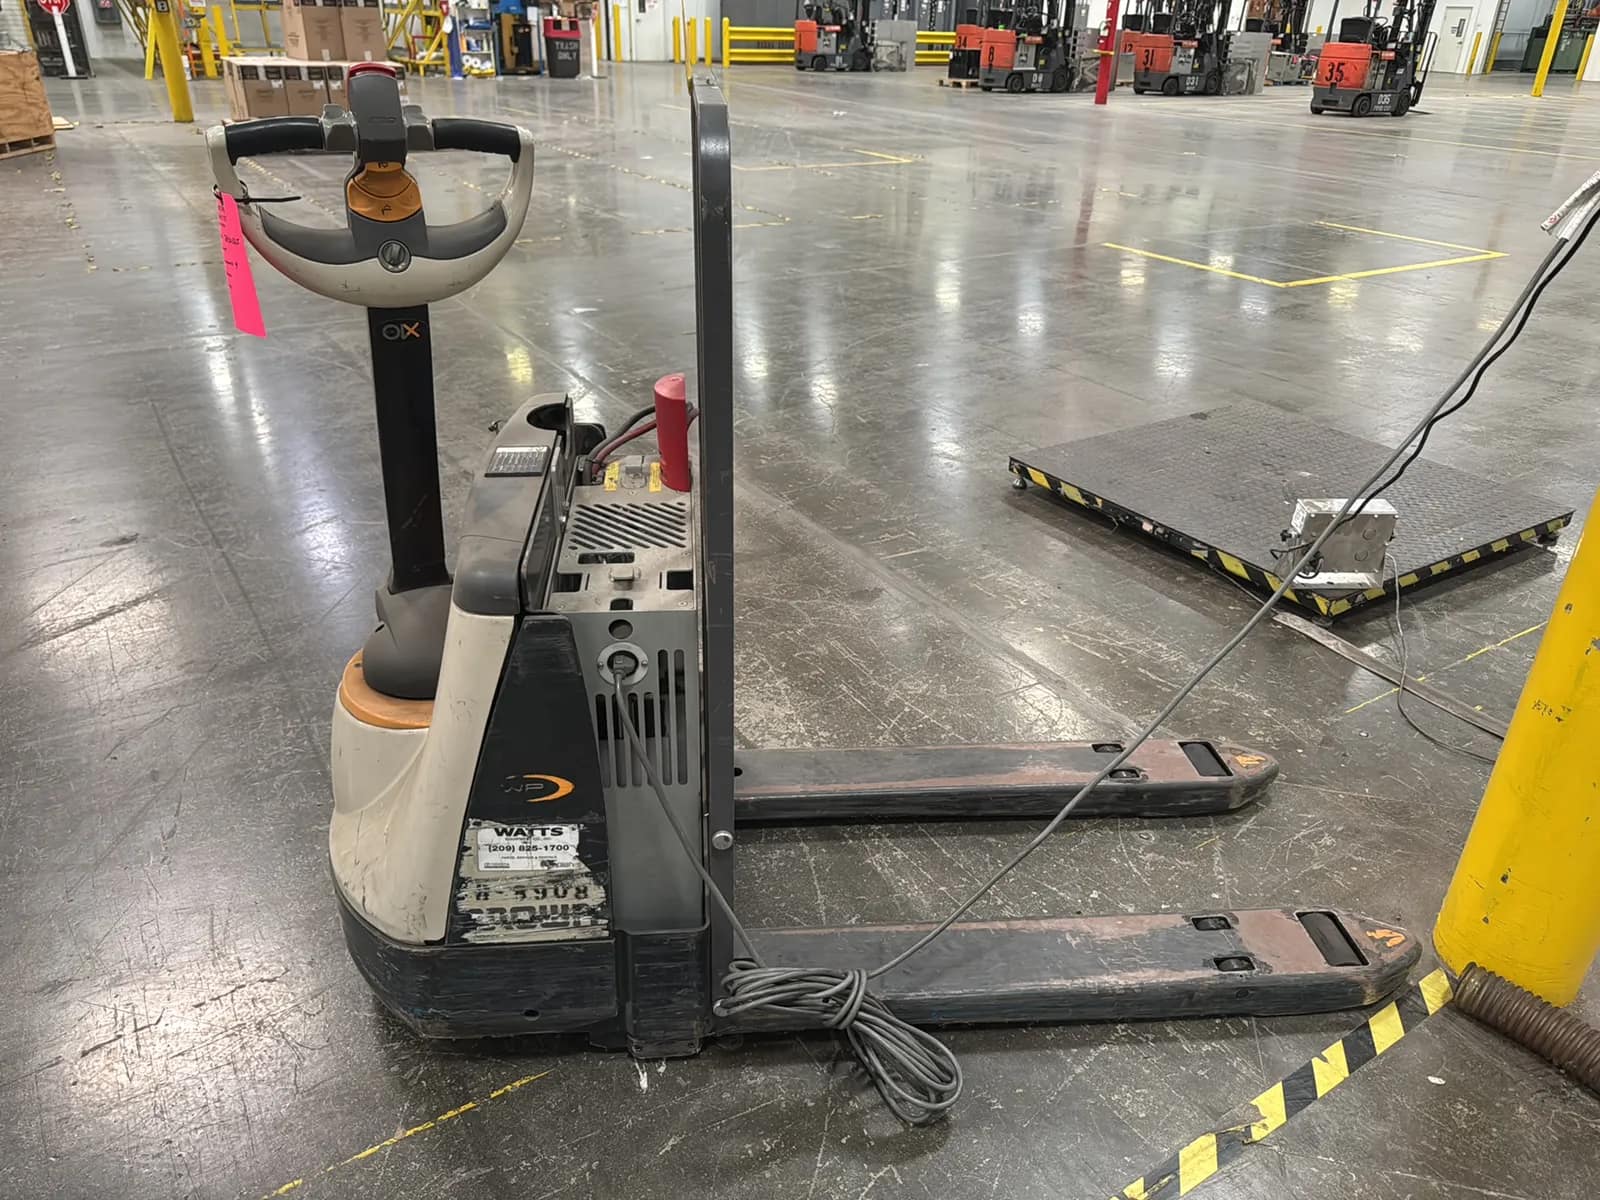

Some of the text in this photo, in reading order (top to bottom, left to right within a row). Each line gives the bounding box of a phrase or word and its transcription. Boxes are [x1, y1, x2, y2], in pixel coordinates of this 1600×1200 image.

[1143, 49, 1155, 66] 31
[1325, 62, 1345, 82] 35
[494, 827, 564, 837] WATTS
[488, 844, 570, 853] (209) 825-1700
